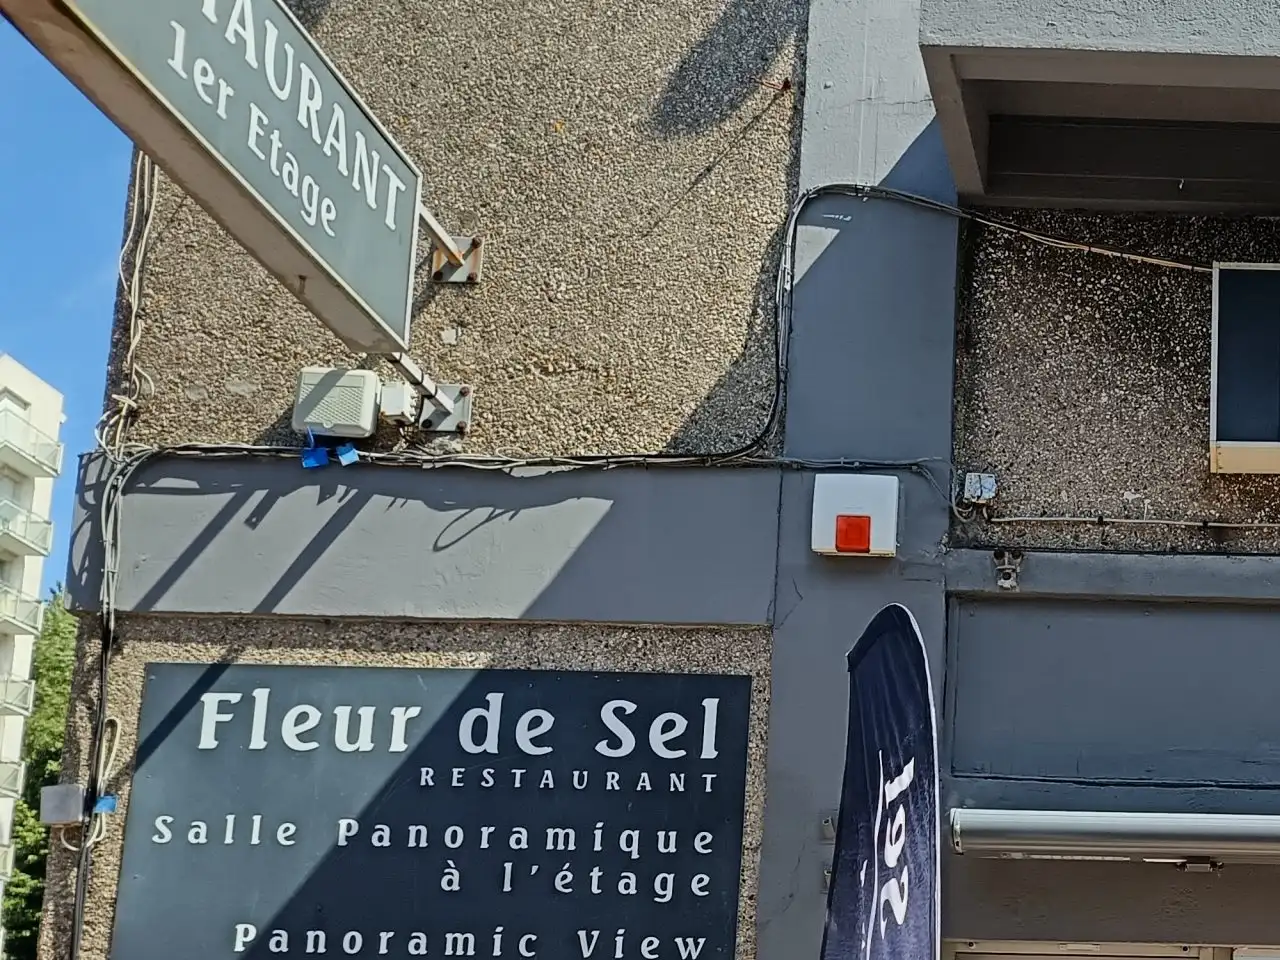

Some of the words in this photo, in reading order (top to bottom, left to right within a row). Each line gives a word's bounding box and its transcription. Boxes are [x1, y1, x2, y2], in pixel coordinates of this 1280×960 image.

[167, 20, 235, 120] 1er
[247, 102, 336, 238] Etage
[202, 0, 406, 231] AURANT
[198, 687, 421, 751] Fleur
[458, 693, 556, 756] de
[595, 698, 720, 760] Sel
[420, 767, 719, 793] RESTAURANT
[153, 815, 298, 845] Salle
[337, 819, 714, 859] Panoramique
[441, 861, 460, 892] à
[504, 864, 711, 902] l'étage
[235, 924, 537, 958] Panoramic
[578, 929, 706, 960] View
